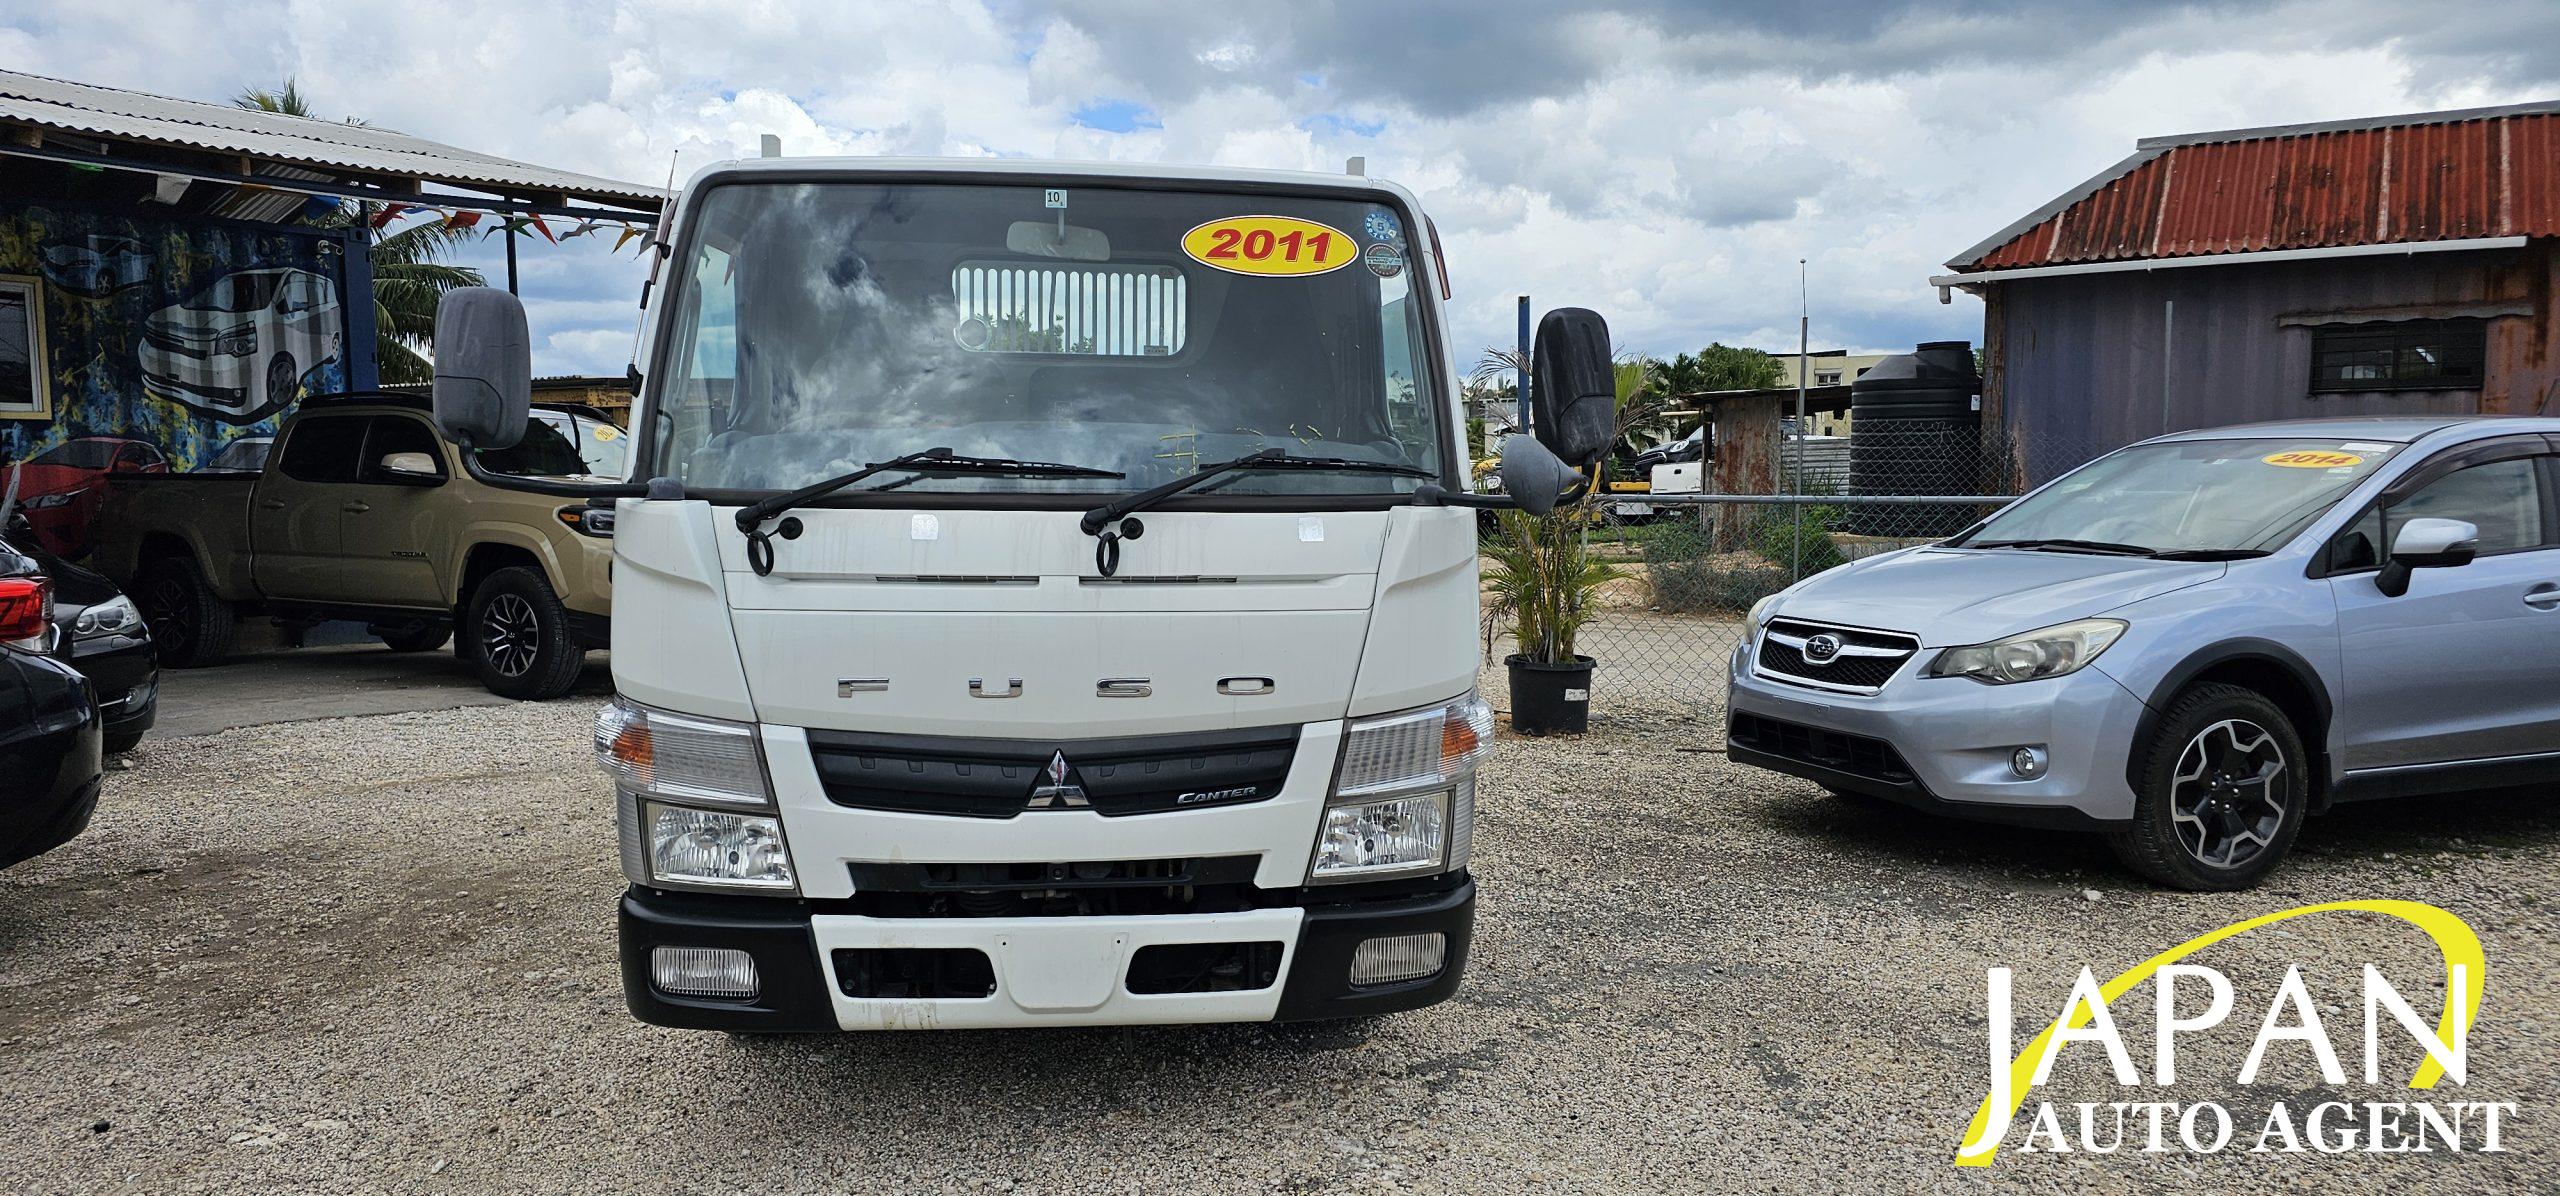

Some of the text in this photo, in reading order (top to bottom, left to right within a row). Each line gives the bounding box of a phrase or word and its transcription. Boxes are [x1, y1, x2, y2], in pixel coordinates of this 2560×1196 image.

[1047, 191, 1060, 203] 10
[1377, 222, 1385, 231] 5
[1205, 228, 1331, 264] 2011
[2271, 453, 2354, 465] 2014
[838, 677, 1276, 698] FUSO
[1177, 786, 1257, 804] CANTER
